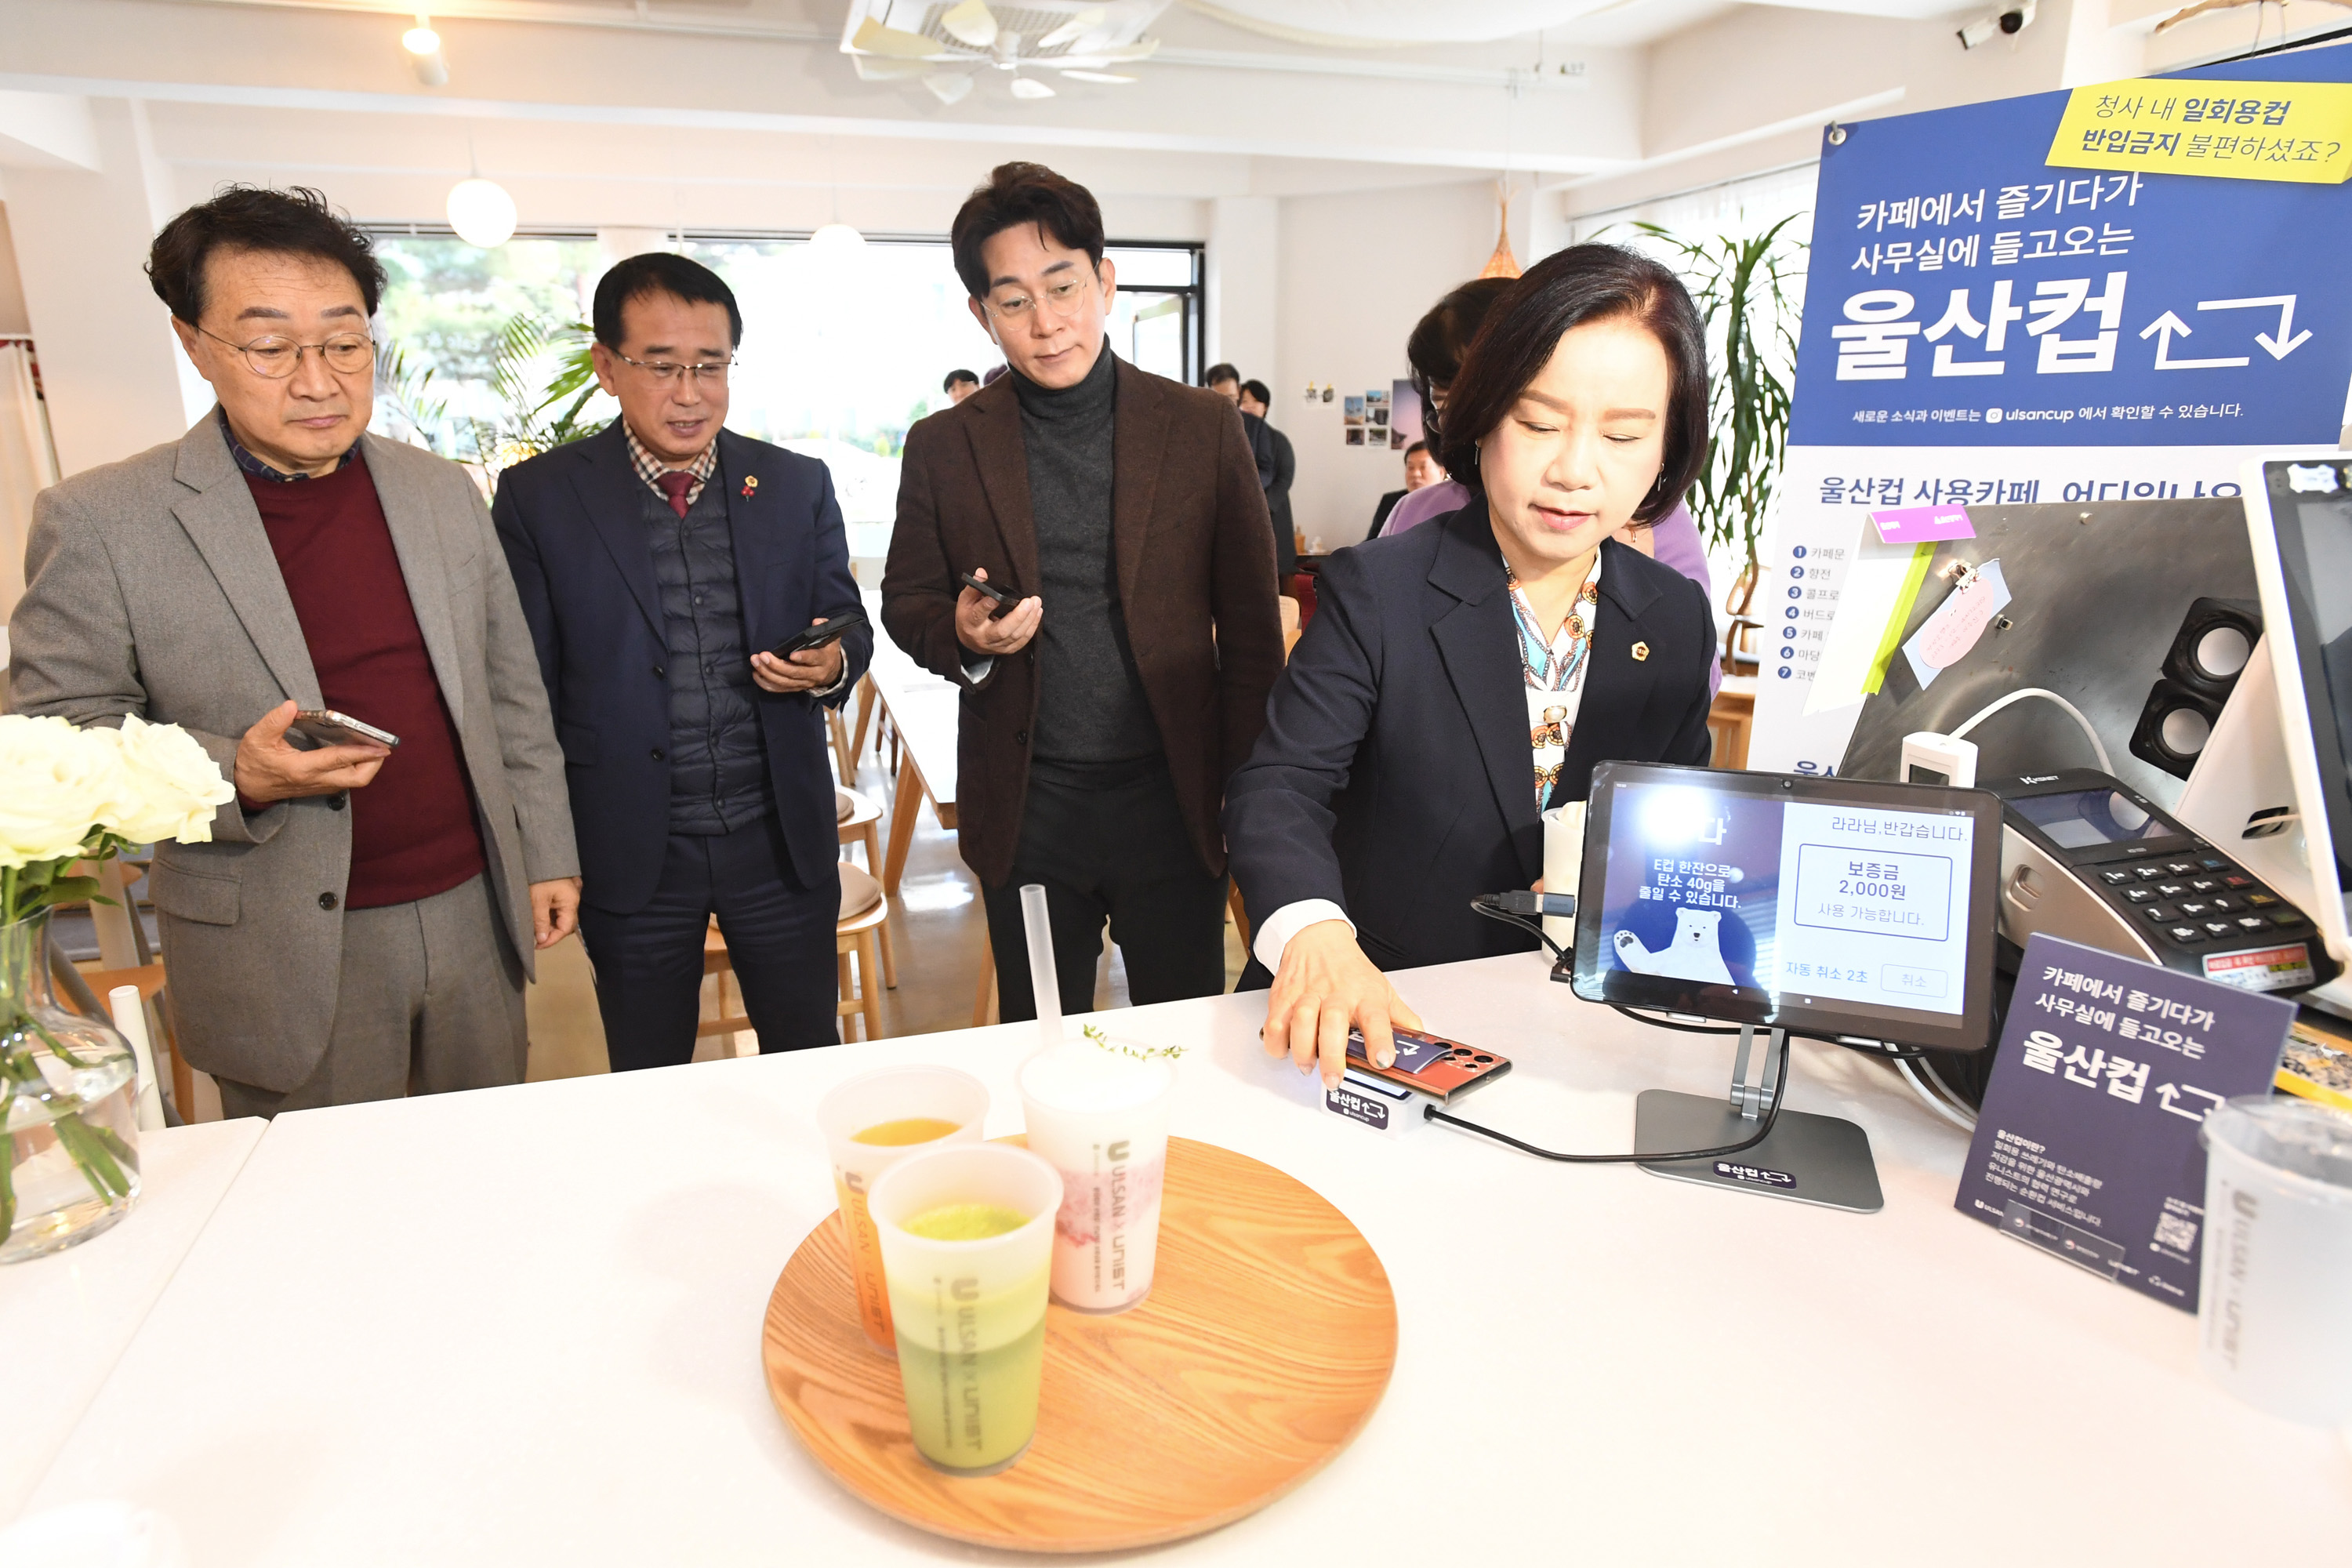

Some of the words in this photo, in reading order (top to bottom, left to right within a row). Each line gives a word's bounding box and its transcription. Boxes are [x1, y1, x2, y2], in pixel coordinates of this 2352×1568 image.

[2096, 95, 2143, 119] 청사
[2150, 97, 2177, 121] 내
[2183, 98, 2291, 125] 일회용컵
[2082, 129, 2181, 156] 반입금지
[2186, 134, 2340, 162] 불편하셨죠?
[1857, 189, 1985, 232] 카페에서
[1996, 171, 2143, 220] 즐기다가
[1851, 234, 1980, 275] 사무실에
[1990, 223, 2134, 265] 들고오는
[1831, 271, 2128, 381] 울산컵
[1852, 410, 1888, 423] 새로운
[1891, 409, 1927, 423] 소식과
[1930, 408, 1981, 423] 이벤트는
[2005, 408, 2074, 423] ulsancup
[2078, 407, 2107, 421] 에서
[2111, 405, 2155, 420] 확인할
[2159, 405, 2174, 419] 수
[2178, 403, 2244, 419] 있습니다.
[1820, 477, 1904, 506] 울산컵
[1914, 478, 2040, 506] 사용카페
[1653, 858, 1675, 873] E컵
[1679, 861, 1731, 878] 한잔으로
[1848, 862, 1899, 880] 보증금
[1657, 873, 1683, 887] 탄소
[1686, 877, 1726, 894] 40g을
[1839, 880, 1906, 900] 2,000원
[1639, 886, 1664, 901] 줄일
[1668, 890, 1682, 902] 수
[1686, 891, 1741, 909] 있습니다.
[1818, 903, 1845, 917] 사용
[1850, 906, 1925, 926] 가능합니다.
[1786, 962, 1811, 977] 자동
[1817, 966, 1842, 980] 취소
[1846, 970, 1868, 983] 2초
[1902, 974, 1927, 988] 취소
[2042, 966, 2123, 1004] 카페에서
[2127, 989, 2216, 1032] 즐기다가
[2034, 993, 2116, 1032] 사무실에
[2118, 1017, 2205, 1060] 들고오는
[2023, 1030, 2151, 1104] 울산컵
[1717, 1163, 1758, 1178] 울산컵
[1112, 1165, 1126, 1218] ULSAN
